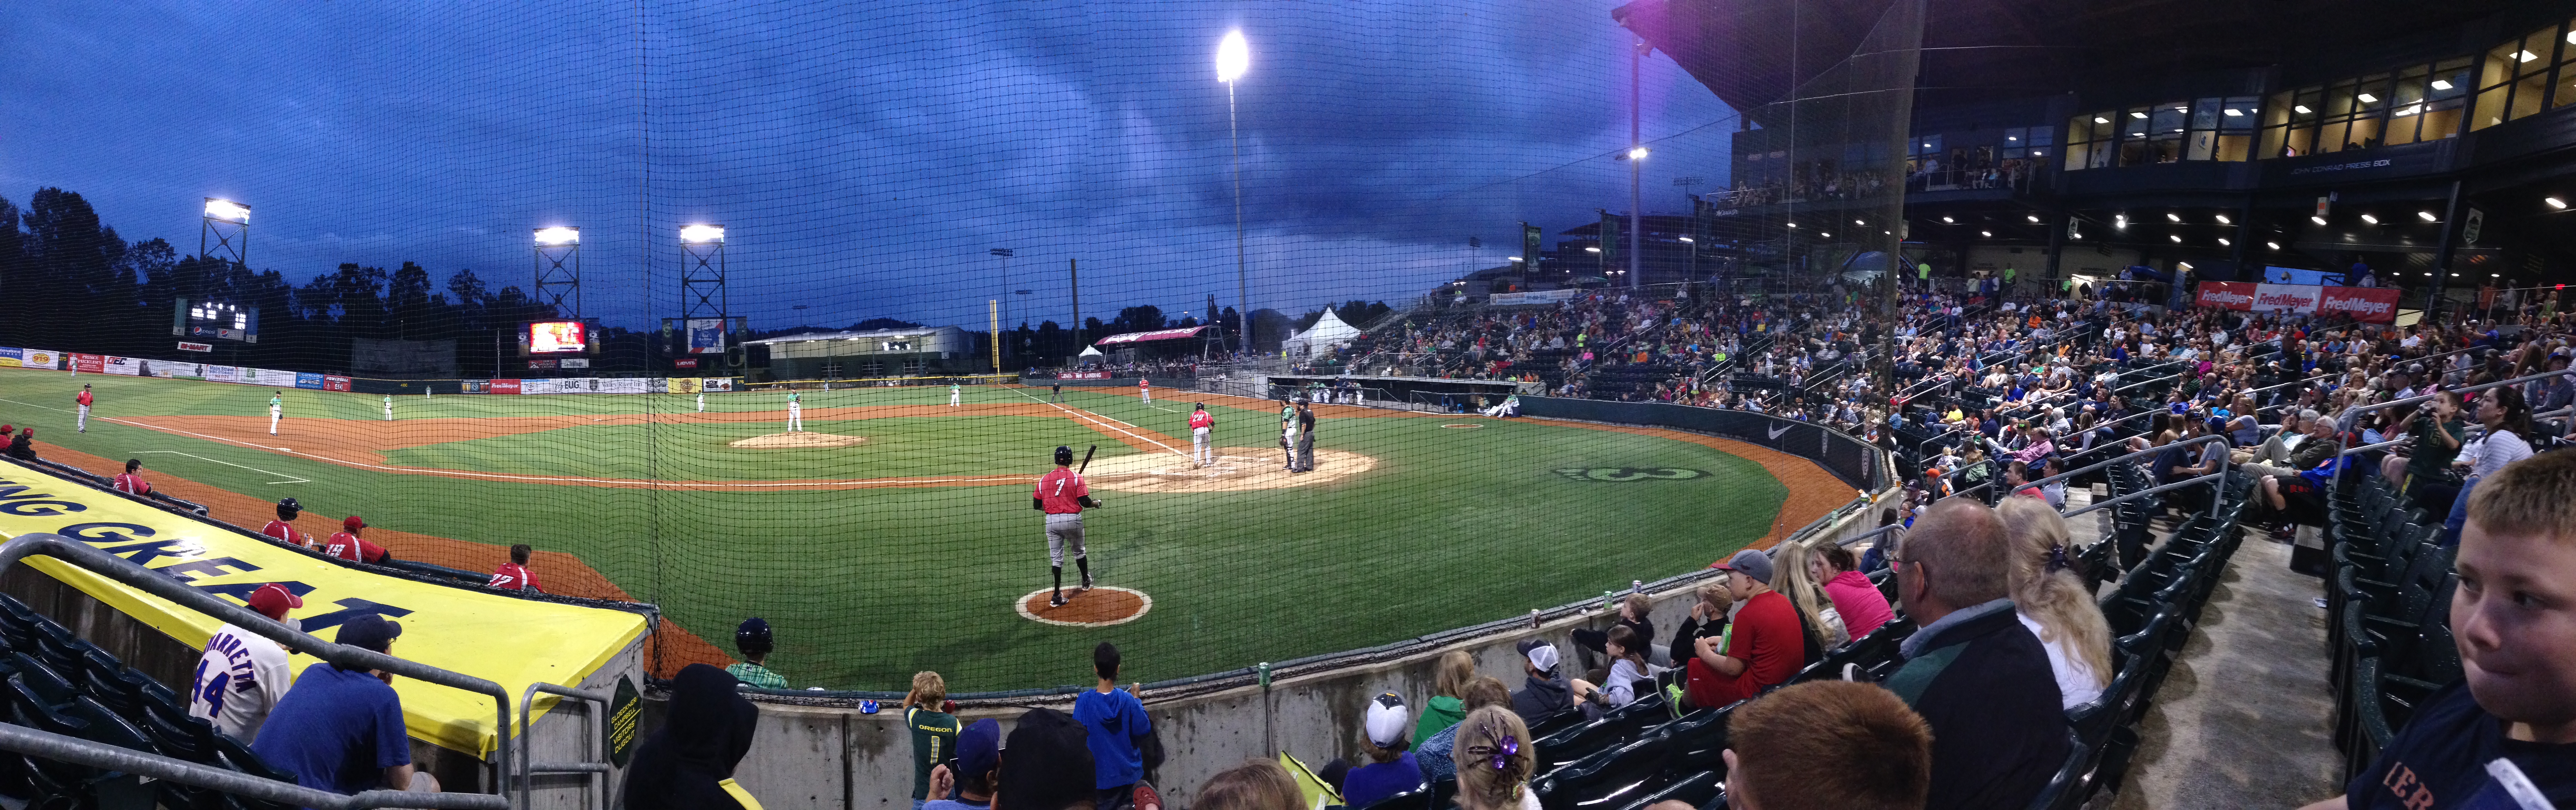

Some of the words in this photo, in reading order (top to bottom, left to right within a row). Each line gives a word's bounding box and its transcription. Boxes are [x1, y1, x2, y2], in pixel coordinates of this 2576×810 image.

[564, 381, 579, 389] EUG
[1193, 414, 1204, 423] 20
[1055, 478, 1066, 497] 7
[193, 658, 231, 719] 44
[614, 707, 636, 730] CAMPBELL
[613, 719, 636, 745] VISITORS'
[615, 729, 635, 754] DUGOUT
[930, 736, 940, 765] 1
